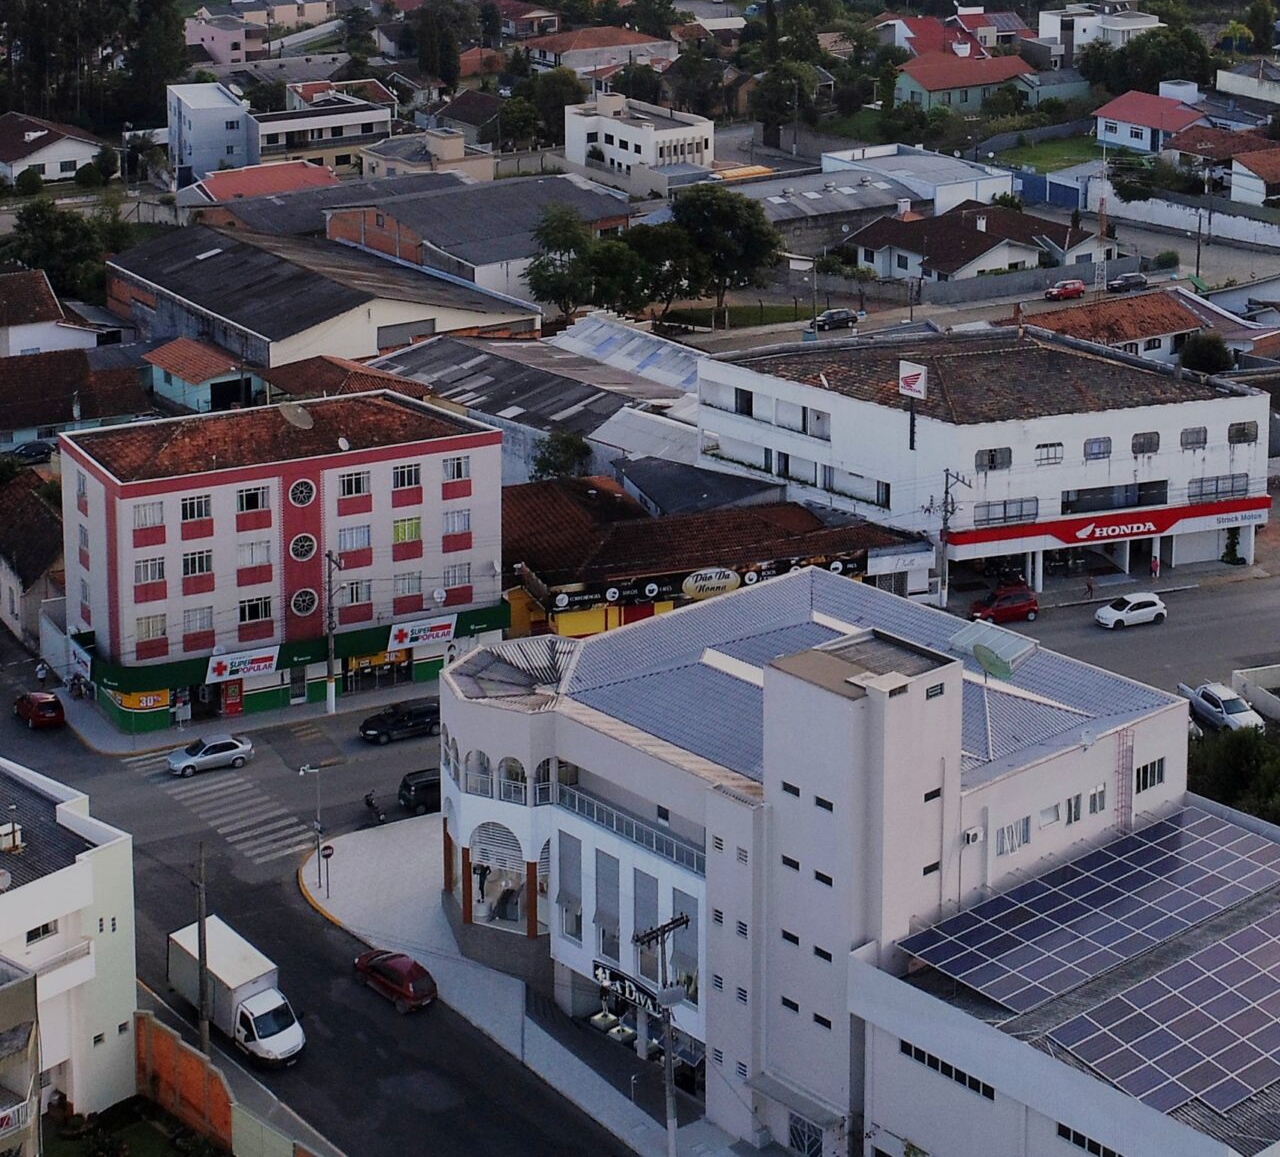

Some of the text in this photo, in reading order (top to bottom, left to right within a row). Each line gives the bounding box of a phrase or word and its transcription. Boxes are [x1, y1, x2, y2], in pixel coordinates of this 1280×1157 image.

[1094, 521, 1157, 537] HONDA
[410, 626, 432, 636] SUPER
[419, 630, 451, 641] POPULAR
[230, 659, 253, 669] SUPER
[239, 663, 273, 674] POPULAR
[140, 695, 162, 707] 30%
